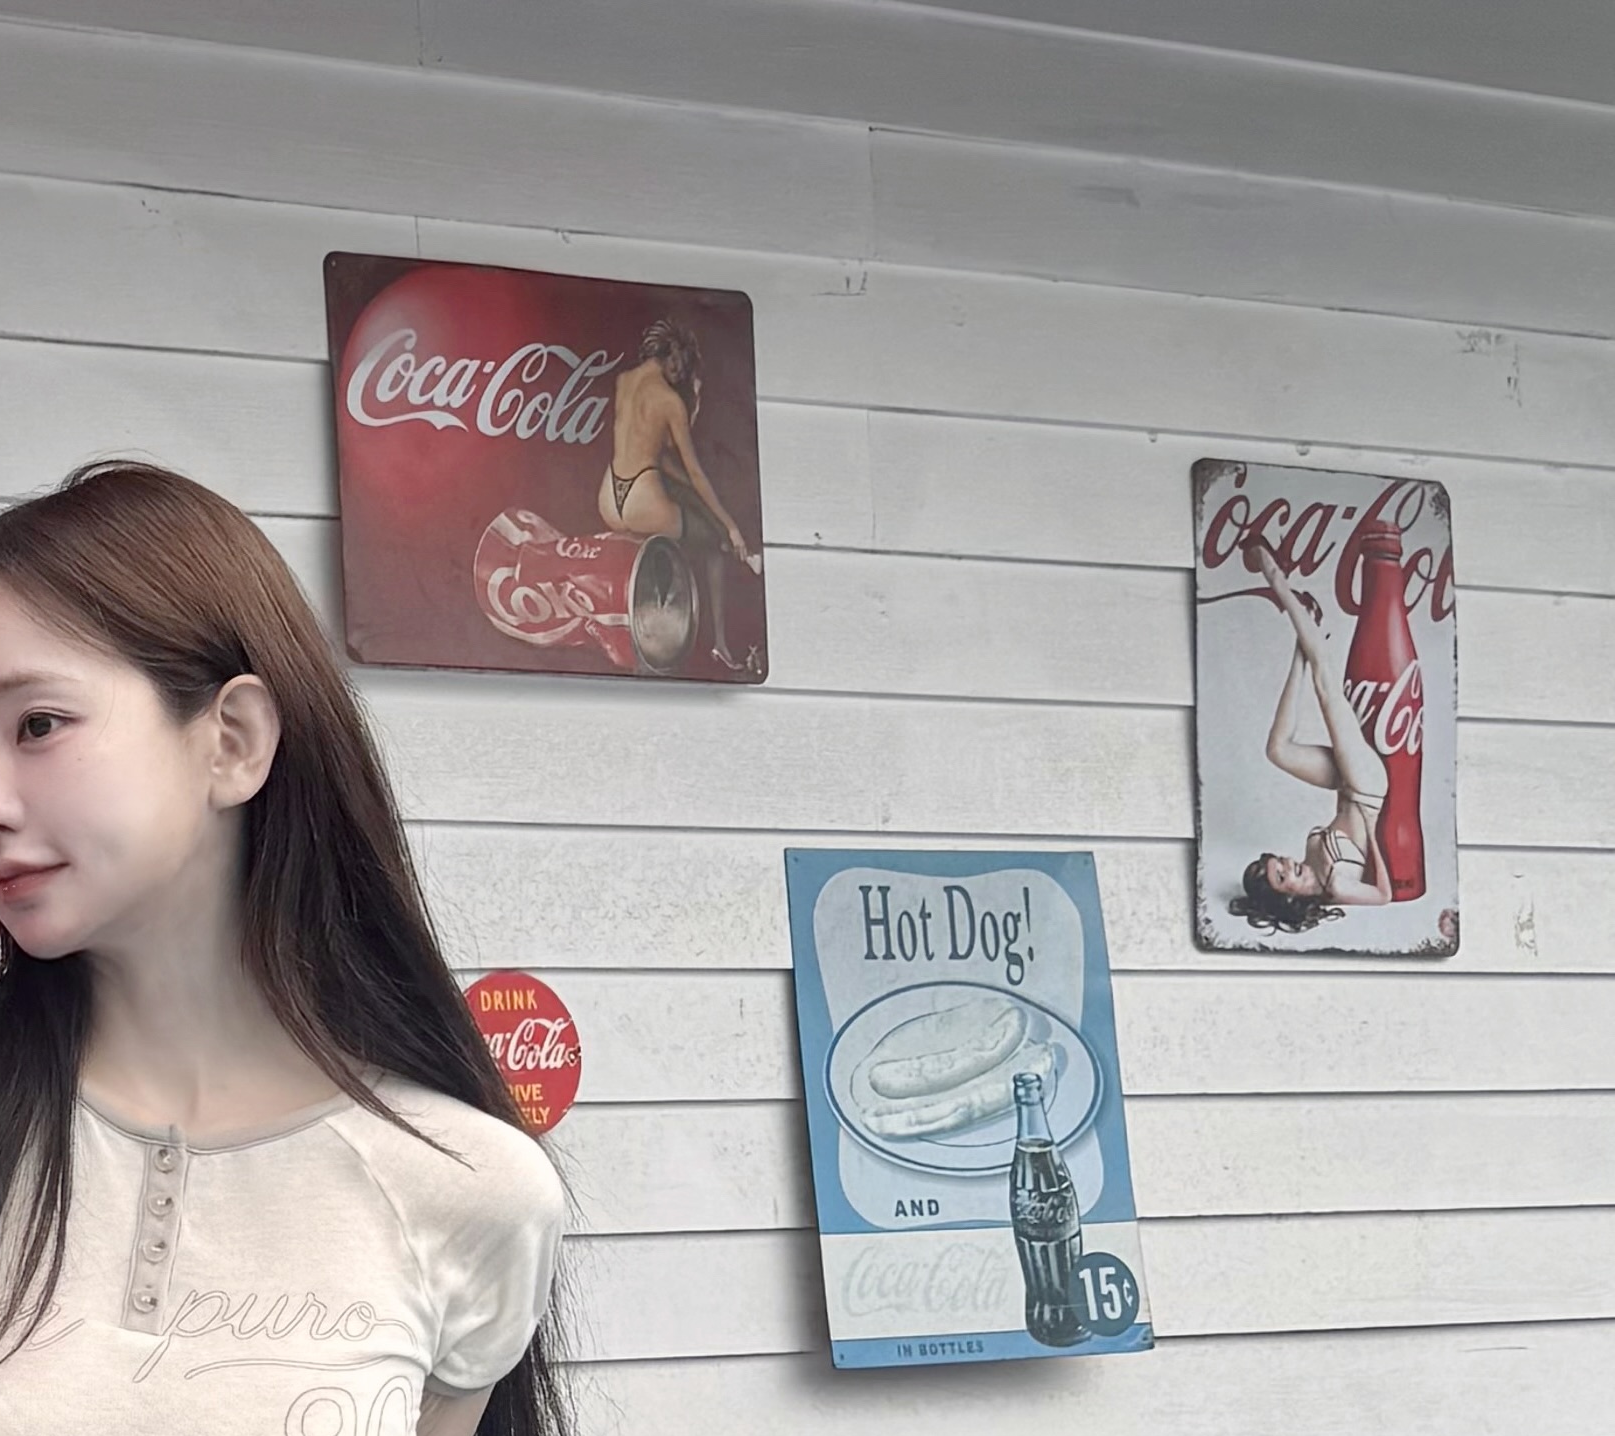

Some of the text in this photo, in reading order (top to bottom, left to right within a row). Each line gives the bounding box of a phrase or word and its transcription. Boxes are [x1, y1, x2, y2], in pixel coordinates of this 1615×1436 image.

[347, 328, 624, 444] Coca-Cola
[858, 885, 1035, 986] Hot Dog!
[480, 988, 538, 1012] DRINK
[508, 1083, 544, 1103] IVE
[894, 1199, 940, 1217] AND
[841, 1240, 1013, 1317] Coca-Cola
[133, 1290, 418, 1383] puro
[897, 1339, 985, 1358] IN BOTTLES
